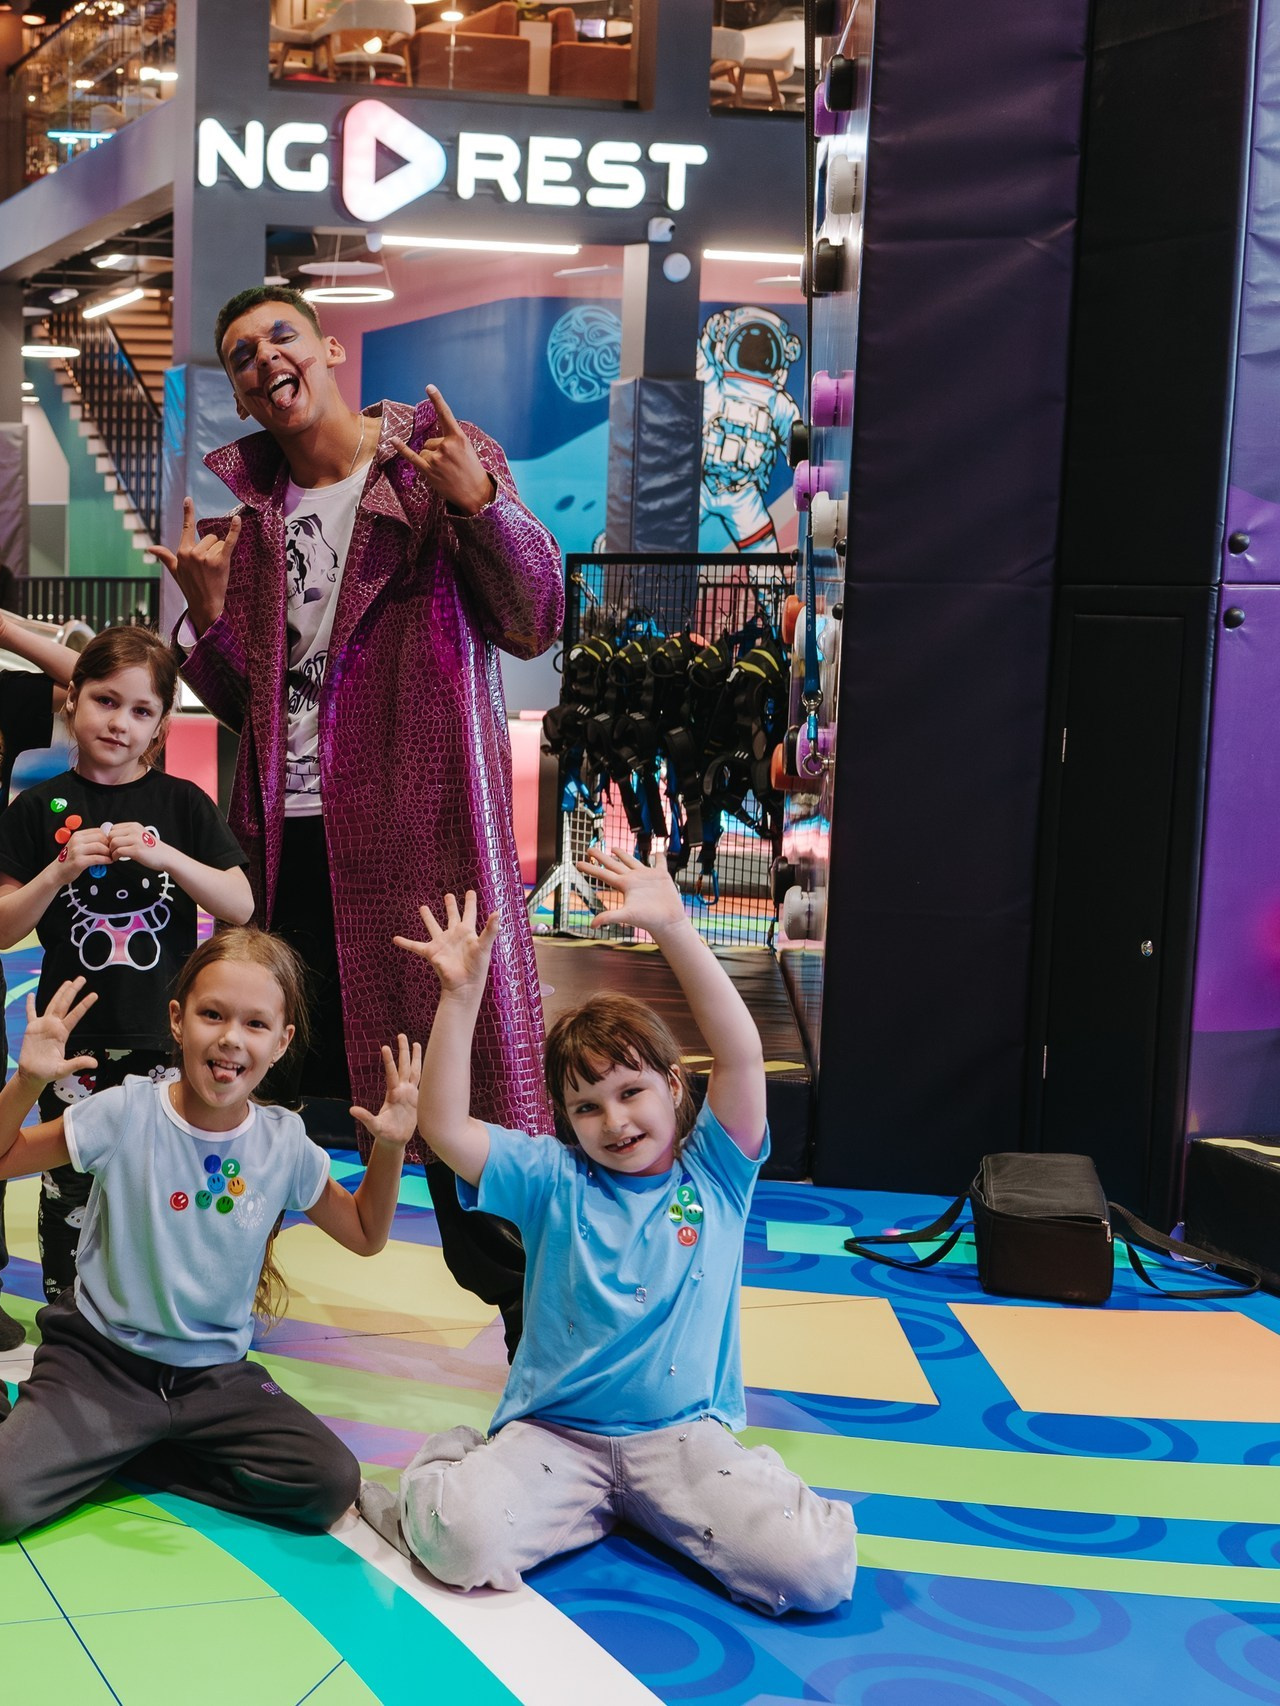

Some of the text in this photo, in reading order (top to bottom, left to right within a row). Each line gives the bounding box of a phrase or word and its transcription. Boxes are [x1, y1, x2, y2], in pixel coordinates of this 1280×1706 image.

[198, 117, 709, 212] NG REST
[227, 1163, 236, 1175] 2
[681, 1190, 690, 1202] 2
